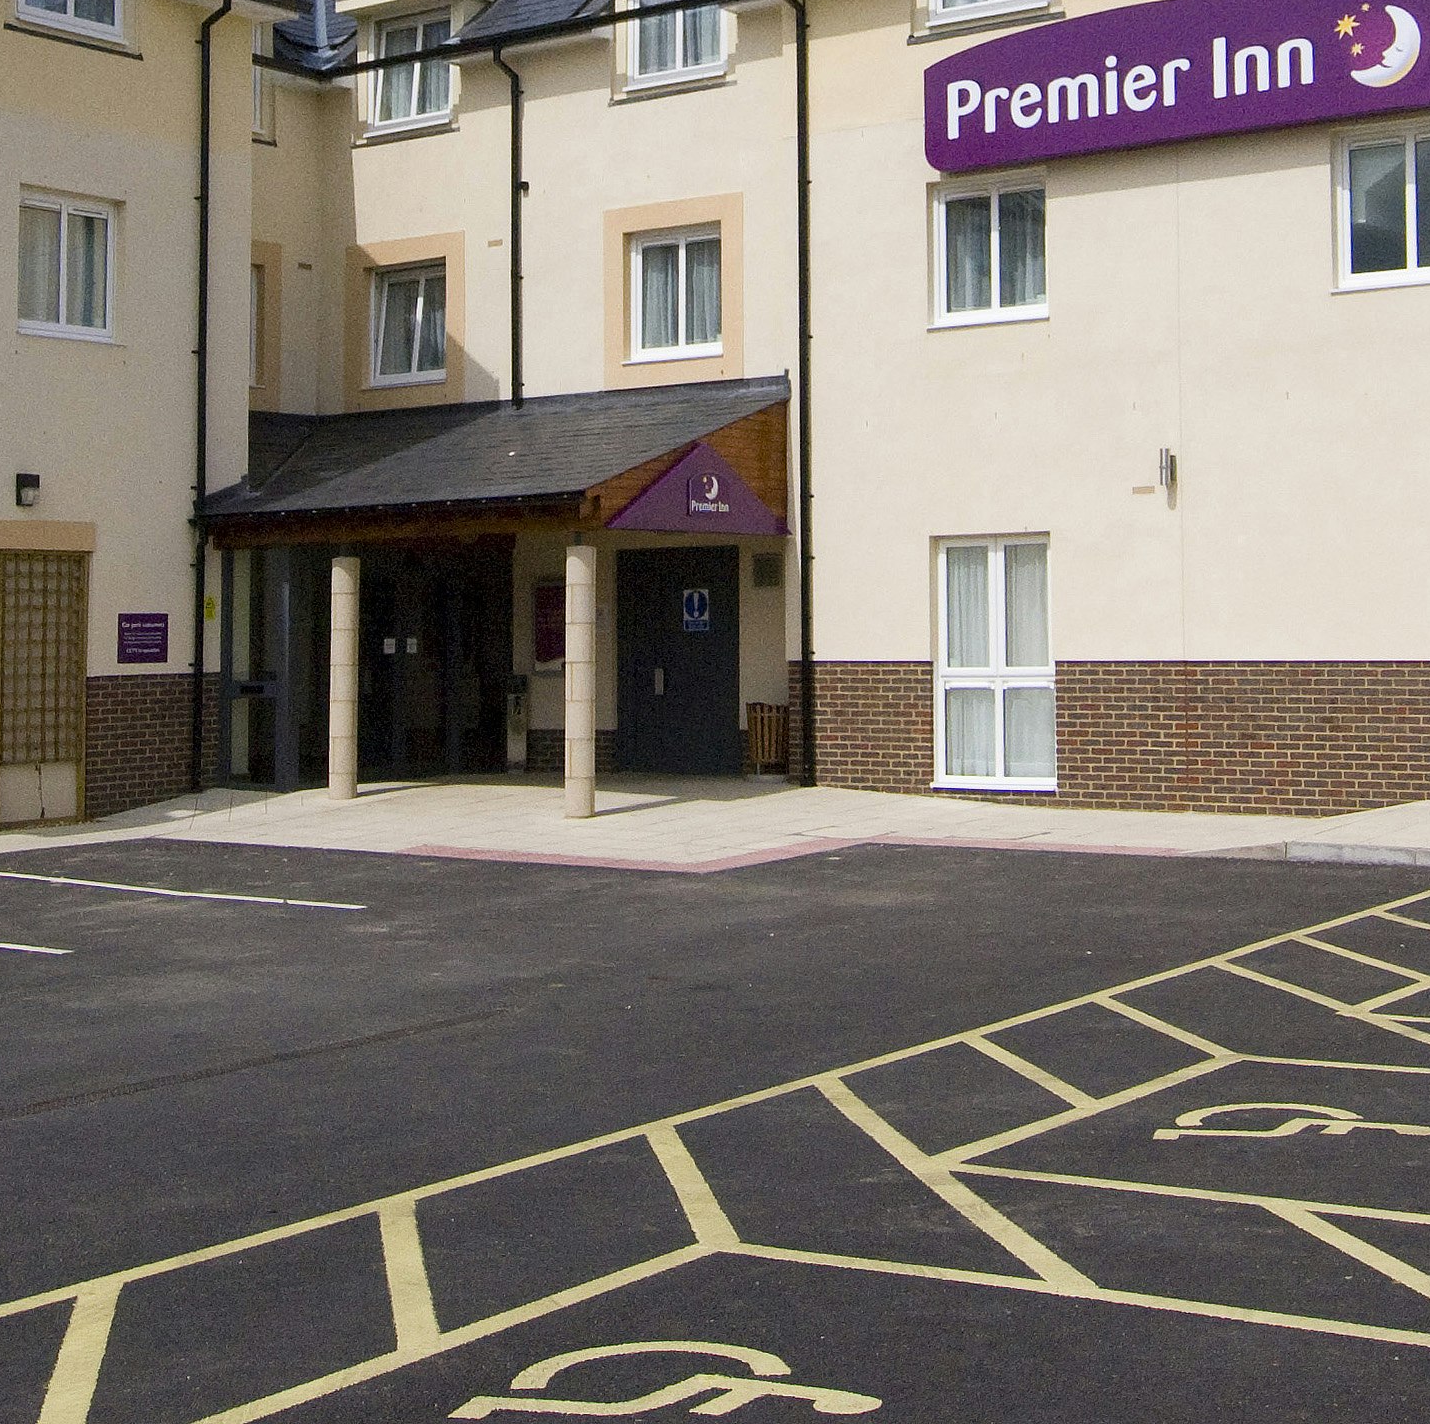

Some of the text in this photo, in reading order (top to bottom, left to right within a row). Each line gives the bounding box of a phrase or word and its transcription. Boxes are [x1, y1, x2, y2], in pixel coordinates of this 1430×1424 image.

[946, 36, 1314, 140] Premier Inn
[691, 499, 717, 512] Premier
